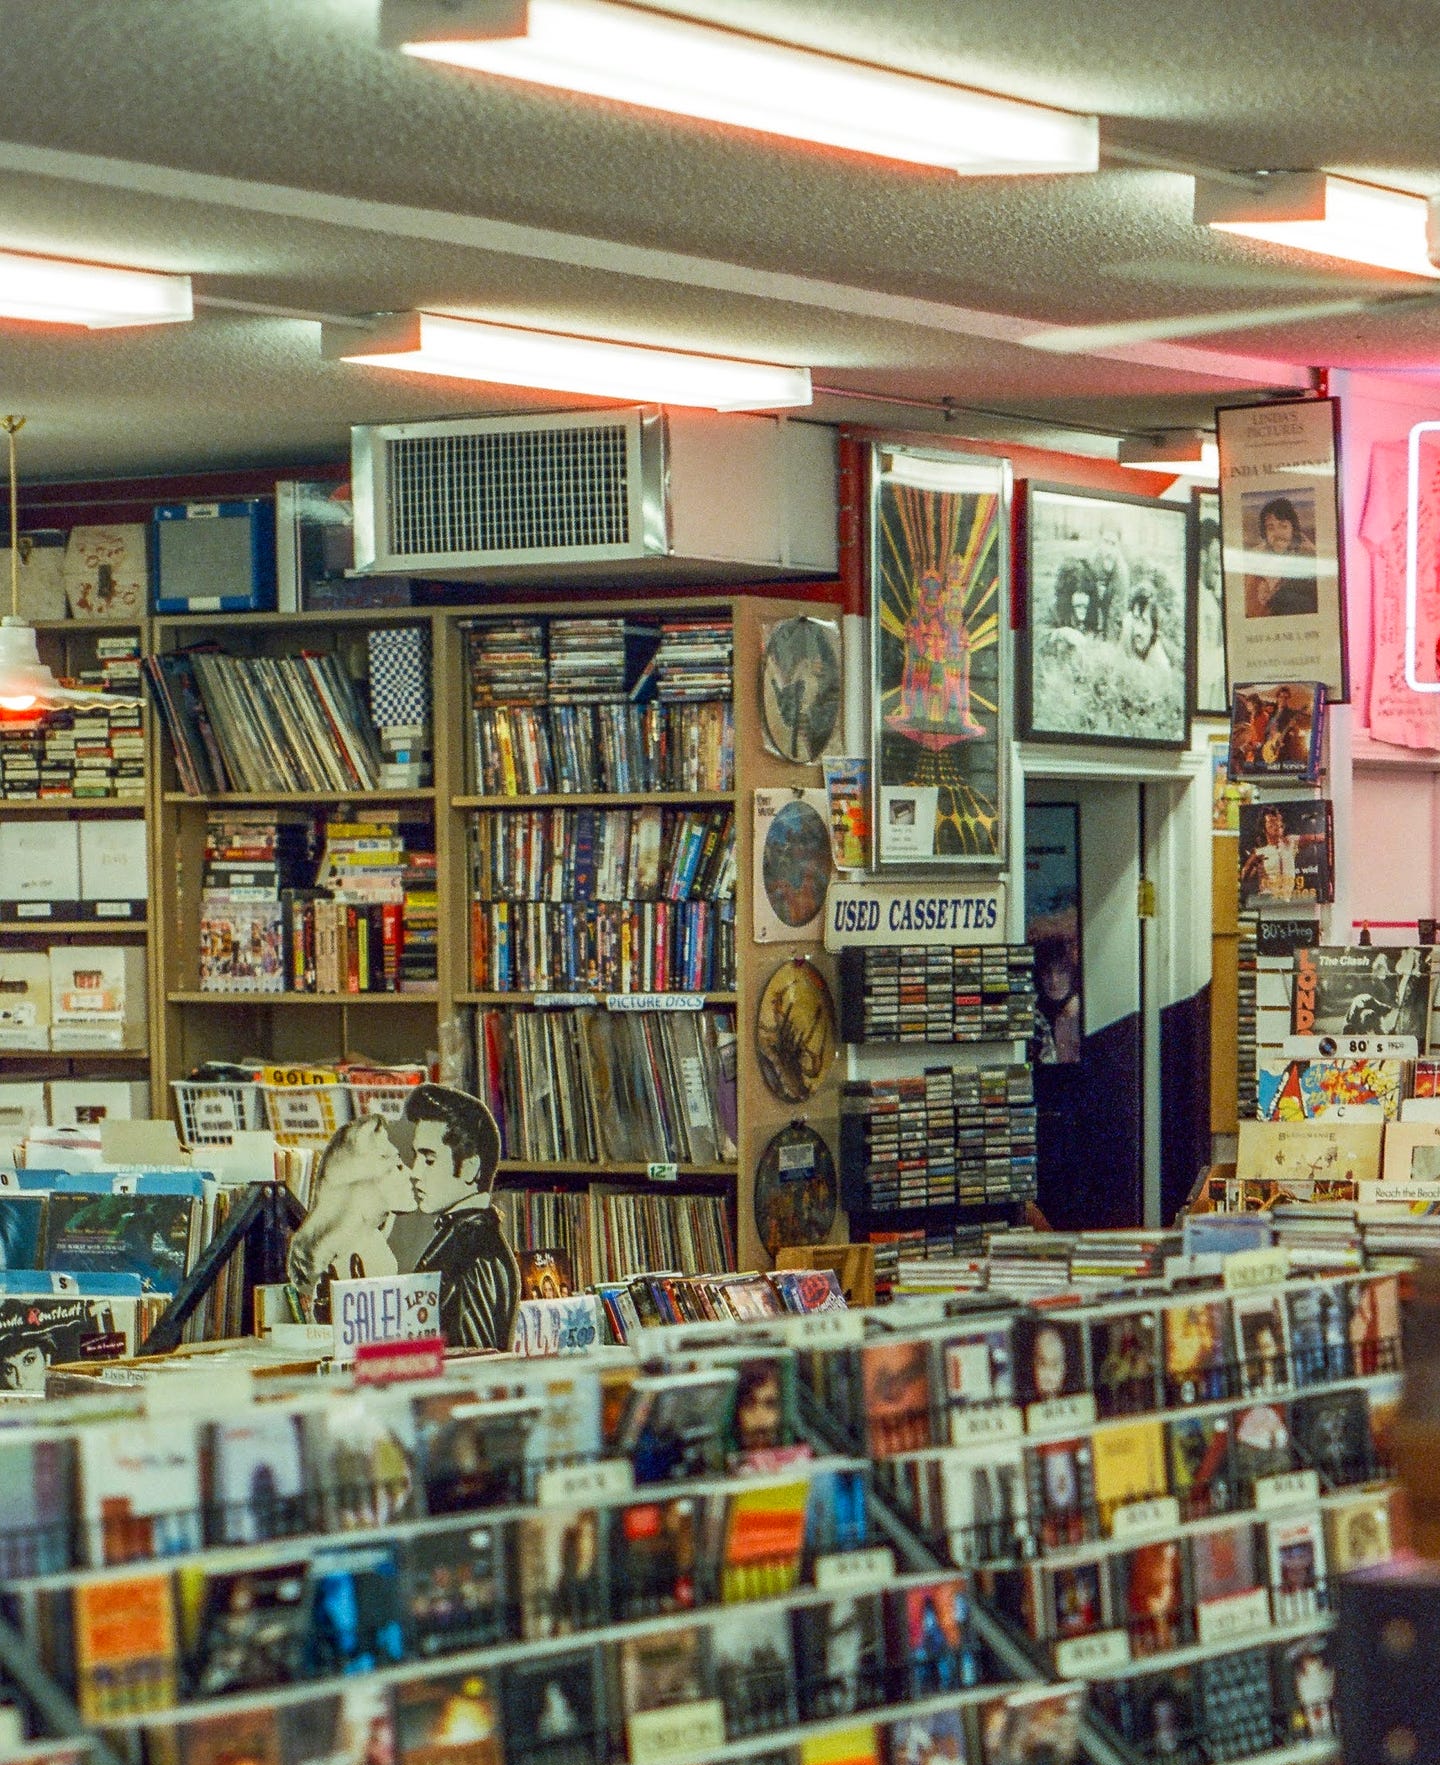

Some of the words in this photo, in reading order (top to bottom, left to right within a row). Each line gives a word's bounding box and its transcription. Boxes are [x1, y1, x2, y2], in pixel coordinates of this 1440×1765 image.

[834, 900, 881, 932] USED
[888, 898, 998, 931] CASSETTES
[1318, 956, 1339, 966] The
[1339, 956, 1370, 967] Clash
[609, 998, 661, 1009] PICTURE
[665, 997, 702, 1008] DISCS
[272, 1069, 325, 1085] GOLD
[1336, 1106, 1346, 1117] C
[1375, 1187, 1400, 1199] Reach
[1402, 1186, 1416, 1198] the
[58, 1277, 68, 1290] S
[26, 1302, 82, 1327] Ronstadt
[342, 1286, 402, 1346] SALE!
[404, 1290, 438, 1310] LP'S
[104, 1370, 125, 1382] Elvis
